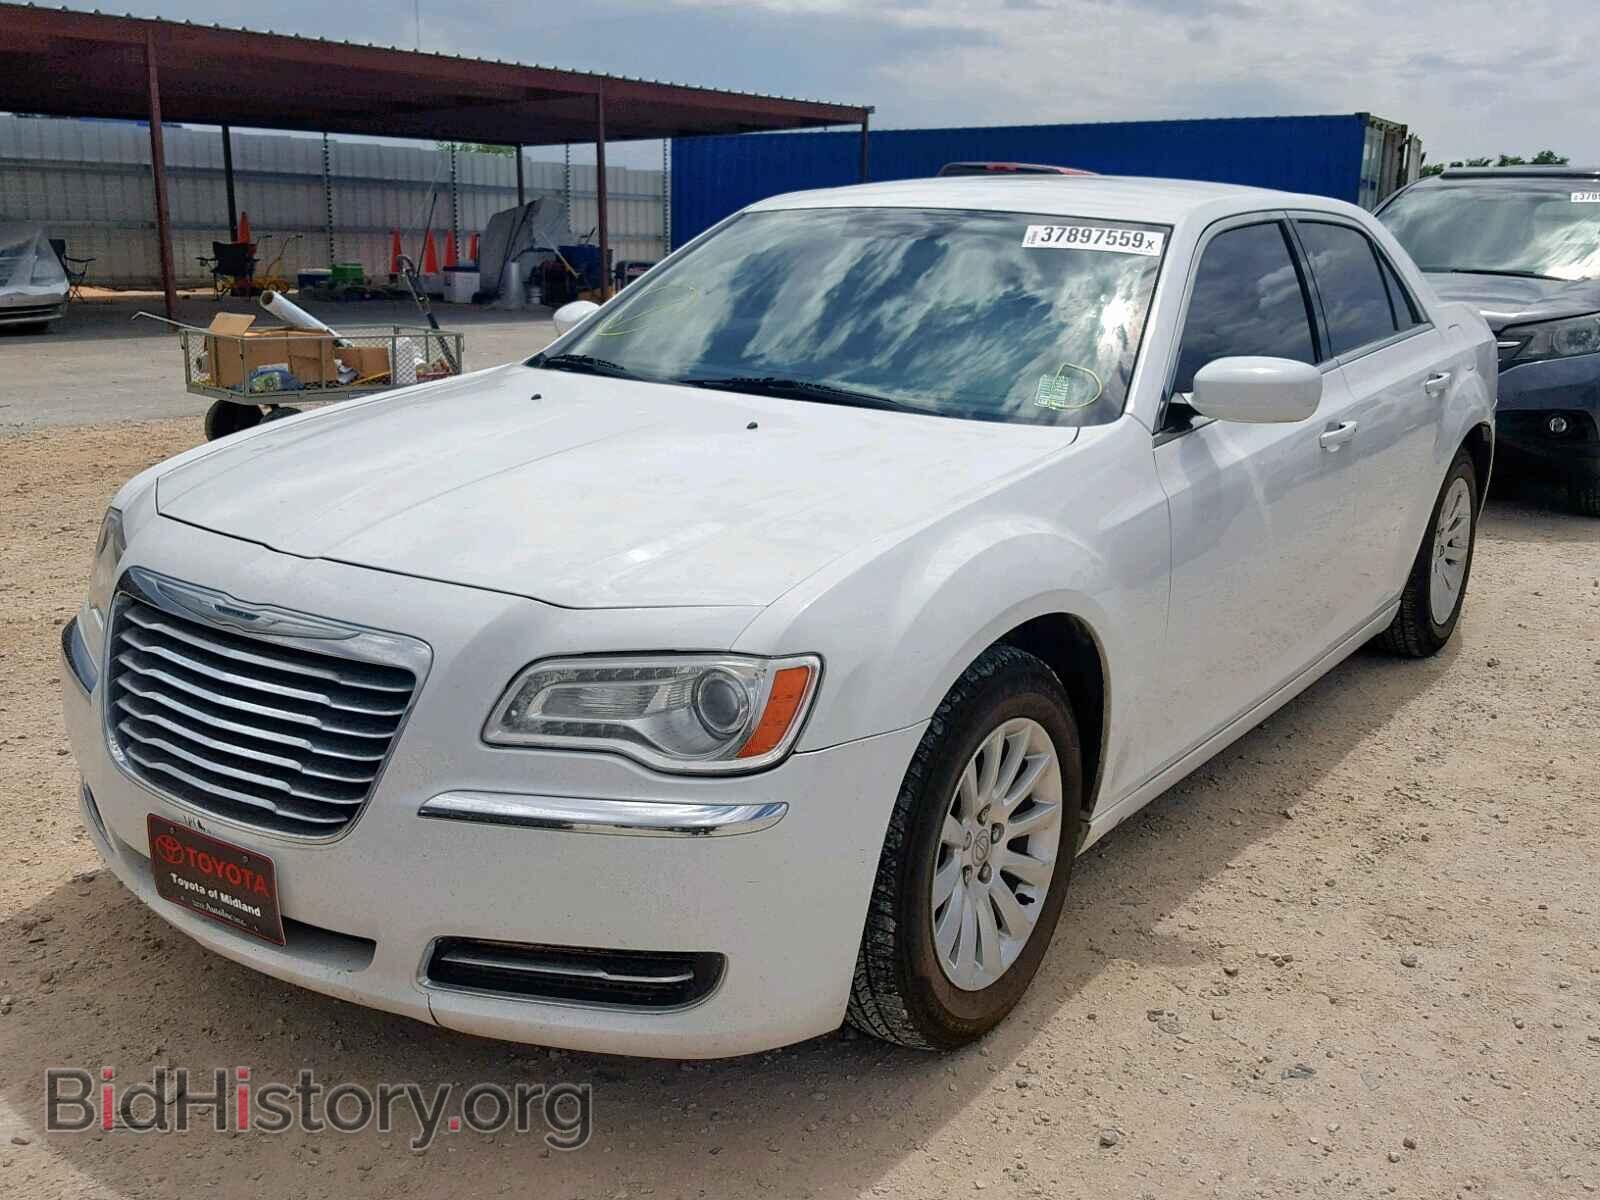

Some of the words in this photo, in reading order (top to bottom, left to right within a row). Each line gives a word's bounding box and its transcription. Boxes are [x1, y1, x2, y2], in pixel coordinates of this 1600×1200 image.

[170, 872, 205, 894] Toyota
[208, 889, 218, 900] of
[220, 893, 261, 917] Midland
[185, 847, 269, 896] TOYOTA
